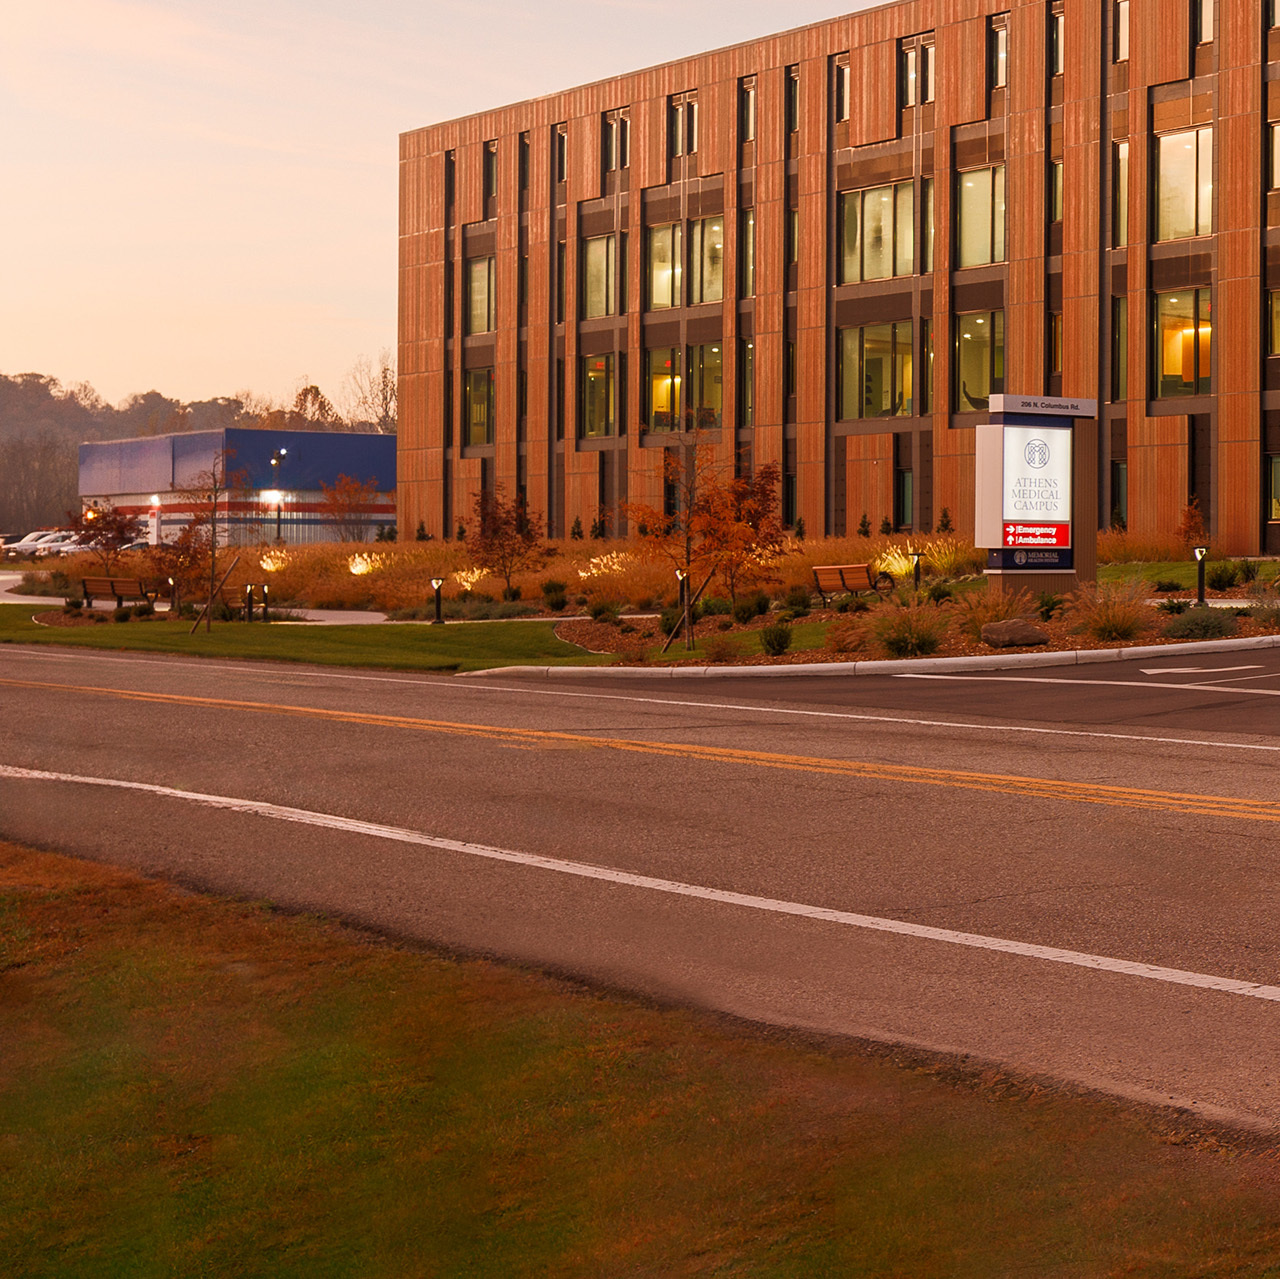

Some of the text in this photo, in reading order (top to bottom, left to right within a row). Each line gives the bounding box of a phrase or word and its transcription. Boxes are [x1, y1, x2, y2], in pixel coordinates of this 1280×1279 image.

[1040, 402, 1069, 410] Columbus
[1014, 477, 1058, 488] ATHENS
[1011, 489, 1061, 500] MEDICAL
[1013, 500, 1059, 511] CAMPUS
[1018, 525, 1057, 535] Emergency
[1018, 536, 1057, 544] Ambulance
